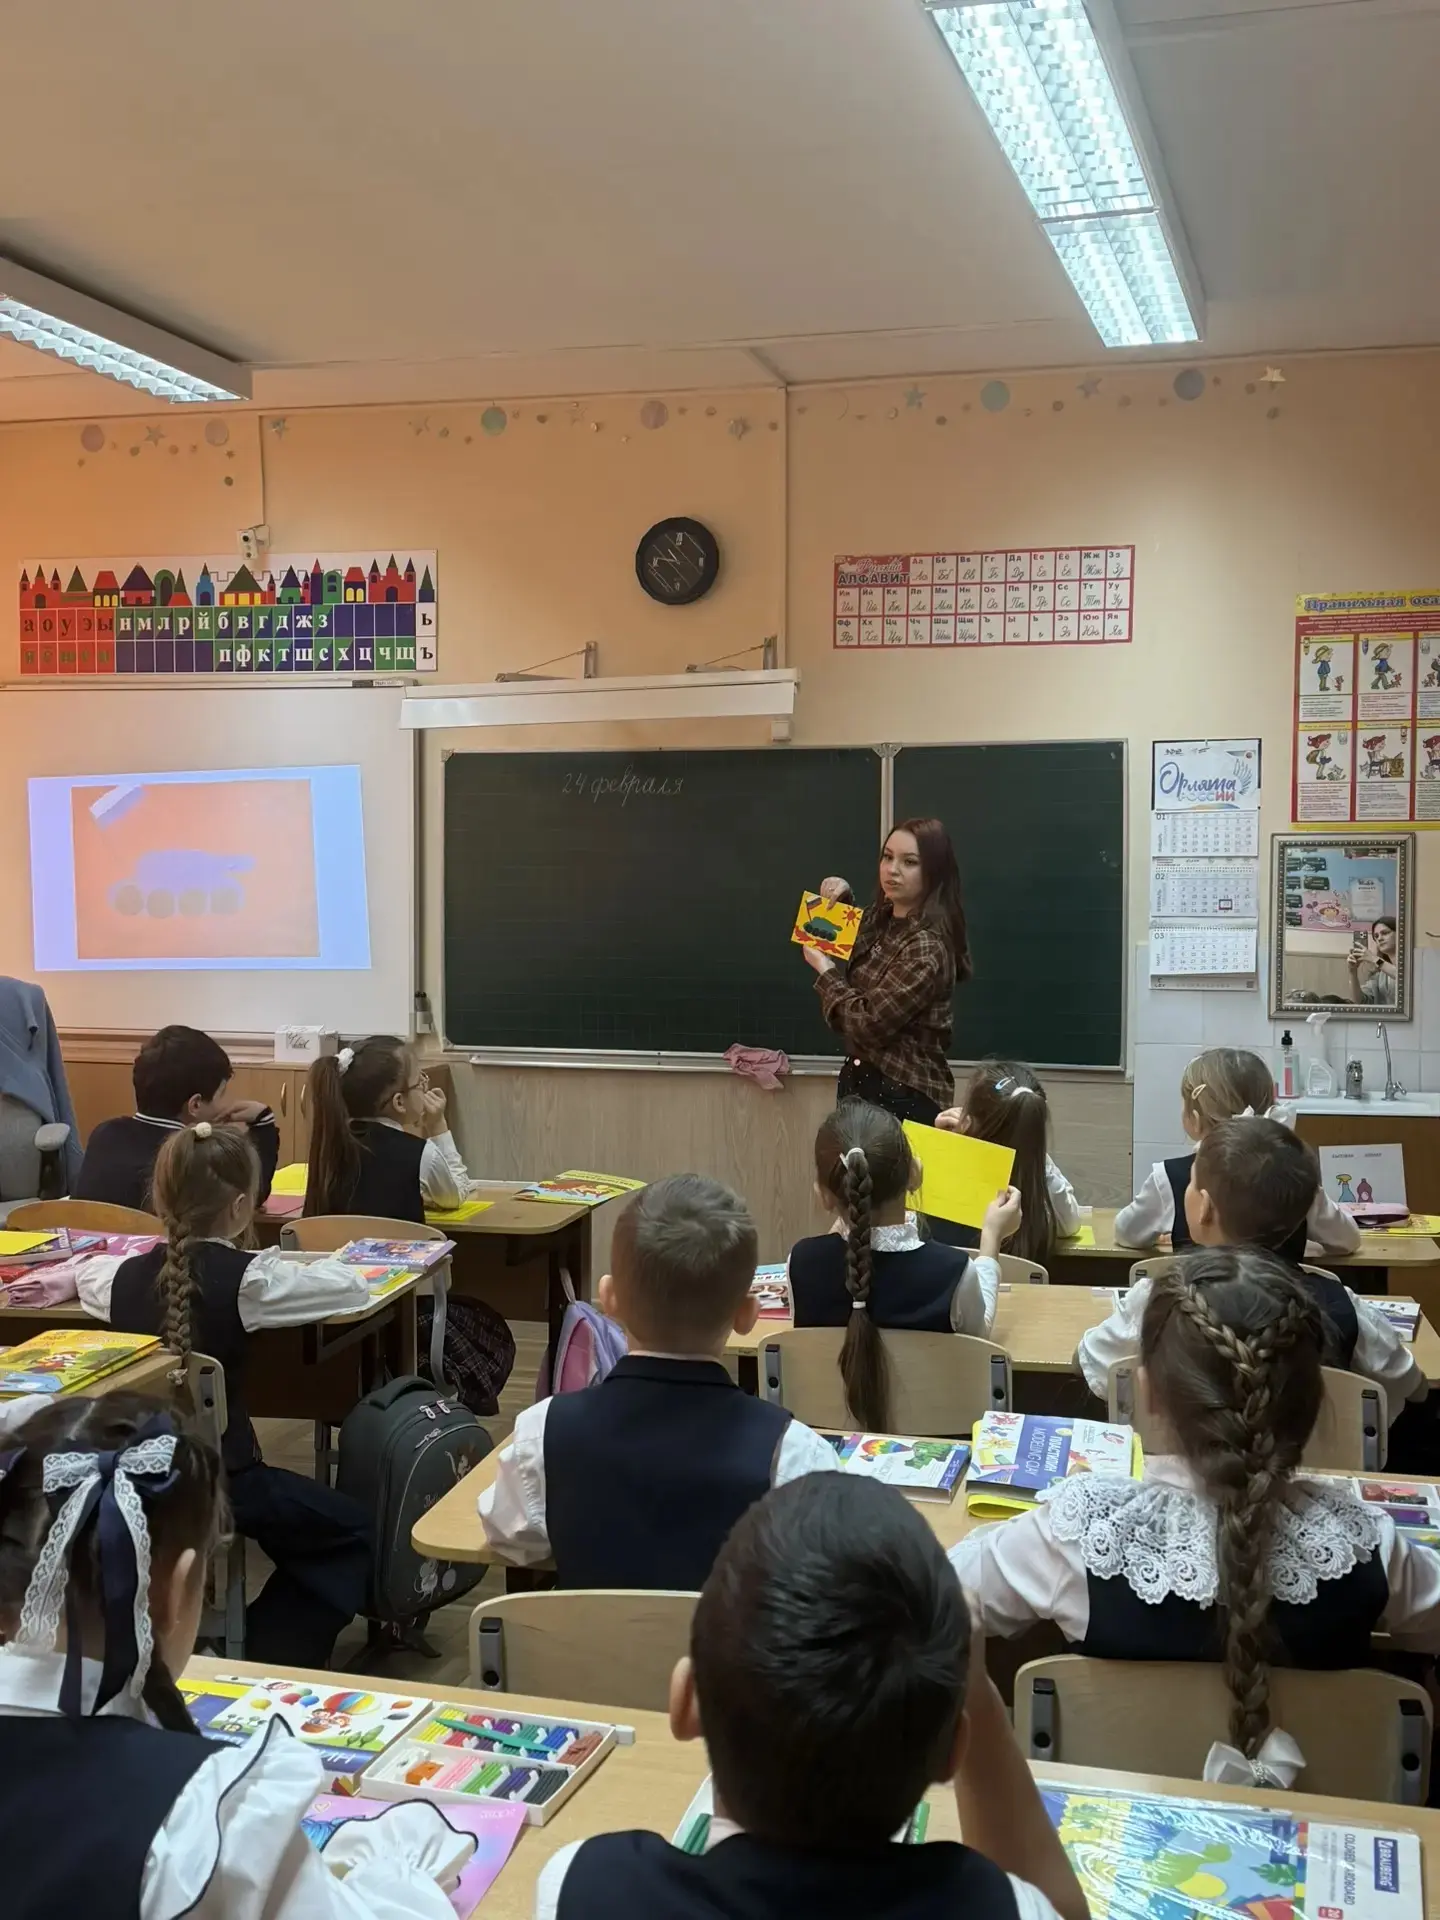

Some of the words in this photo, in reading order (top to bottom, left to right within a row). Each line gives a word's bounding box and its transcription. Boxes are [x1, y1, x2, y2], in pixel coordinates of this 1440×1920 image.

[838, 573, 910, 585] АЛФАВИТ
[1305, 596, 1405, 612] Правильная
[24, 618, 34, 631] а
[43, 618, 53, 632] о
[61, 618, 72, 636] у
[84, 617, 92, 631] э
[98, 618, 113, 631] ы
[120, 618, 131, 631] н
[138, 617, 152, 631] м
[158, 617, 170, 631] л
[179, 617, 190, 635] р
[198, 612, 210, 630] й
[218, 612, 229, 630] б
[238, 615, 249, 629] в
[258, 615, 269, 628] г
[277, 615, 289, 631] д
[296, 615, 313, 628] ж
[319, 614, 328, 628] з
[422, 613, 432, 626] ь
[219, 649, 231, 662] п
[236, 644, 251, 668] ф
[258, 648, 271, 661] к
[278, 648, 290, 661] т
[295, 648, 313, 661] ш
[319, 647, 328, 661] с
[338, 647, 349, 660] х
[359, 647, 372, 664] ц
[379, 647, 391, 660] ч
[396, 646, 415, 662] щ
[420, 646, 433, 659] ъ
[562, 772, 585, 794] 24
[591, 763, 684, 807] февраля
[1160, 762, 1236, 798] Орлята
[1028, 1427, 1047, 1460] MODELING
[1044, 1435, 1063, 1473] ПЛАСТИЛИН
[1025, 1459, 1040, 1476] CLAY
[1379, 1848, 1393, 1888] BRAUBERG
